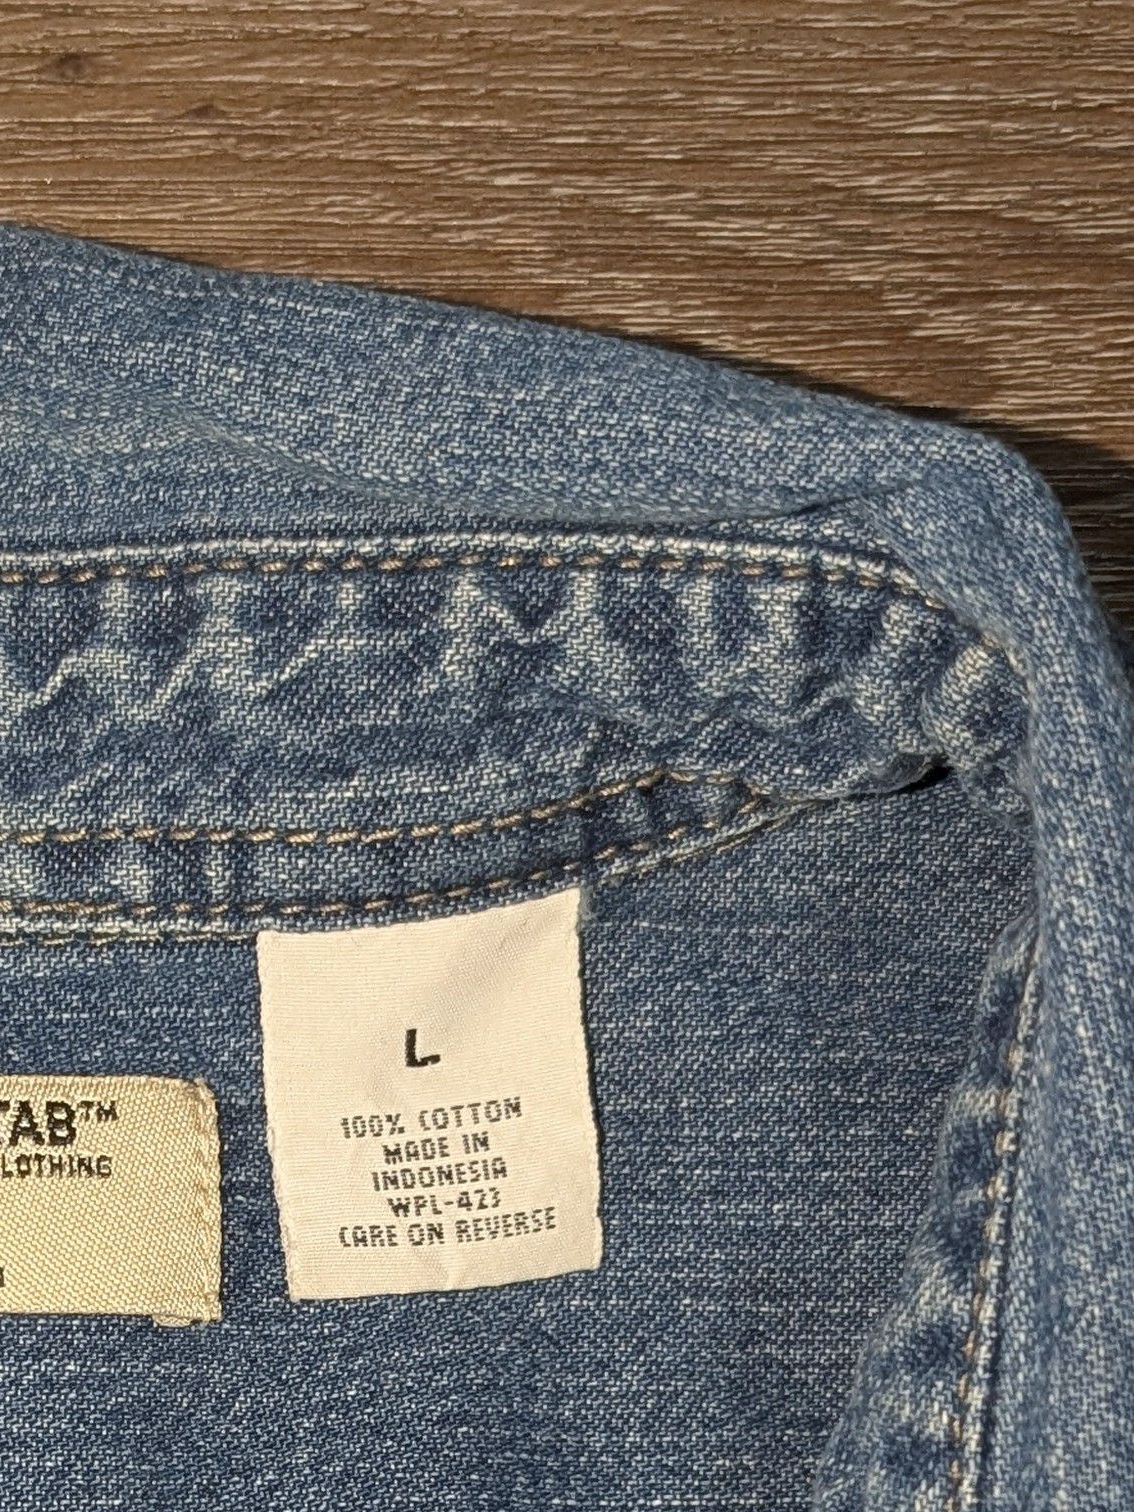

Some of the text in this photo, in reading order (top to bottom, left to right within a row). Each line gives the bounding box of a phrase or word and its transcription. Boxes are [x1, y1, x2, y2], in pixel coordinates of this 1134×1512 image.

[405, 1028, 441, 1068] L
[341, 1096, 522, 1139] 100% COTTON
[382, 1131, 491, 1165] MADE IN
[371, 1157, 508, 1192] INDONESIA
[387, 1187, 502, 1218] WPL-423
[338, 1206, 557, 1247] CARE ON REVERSE
